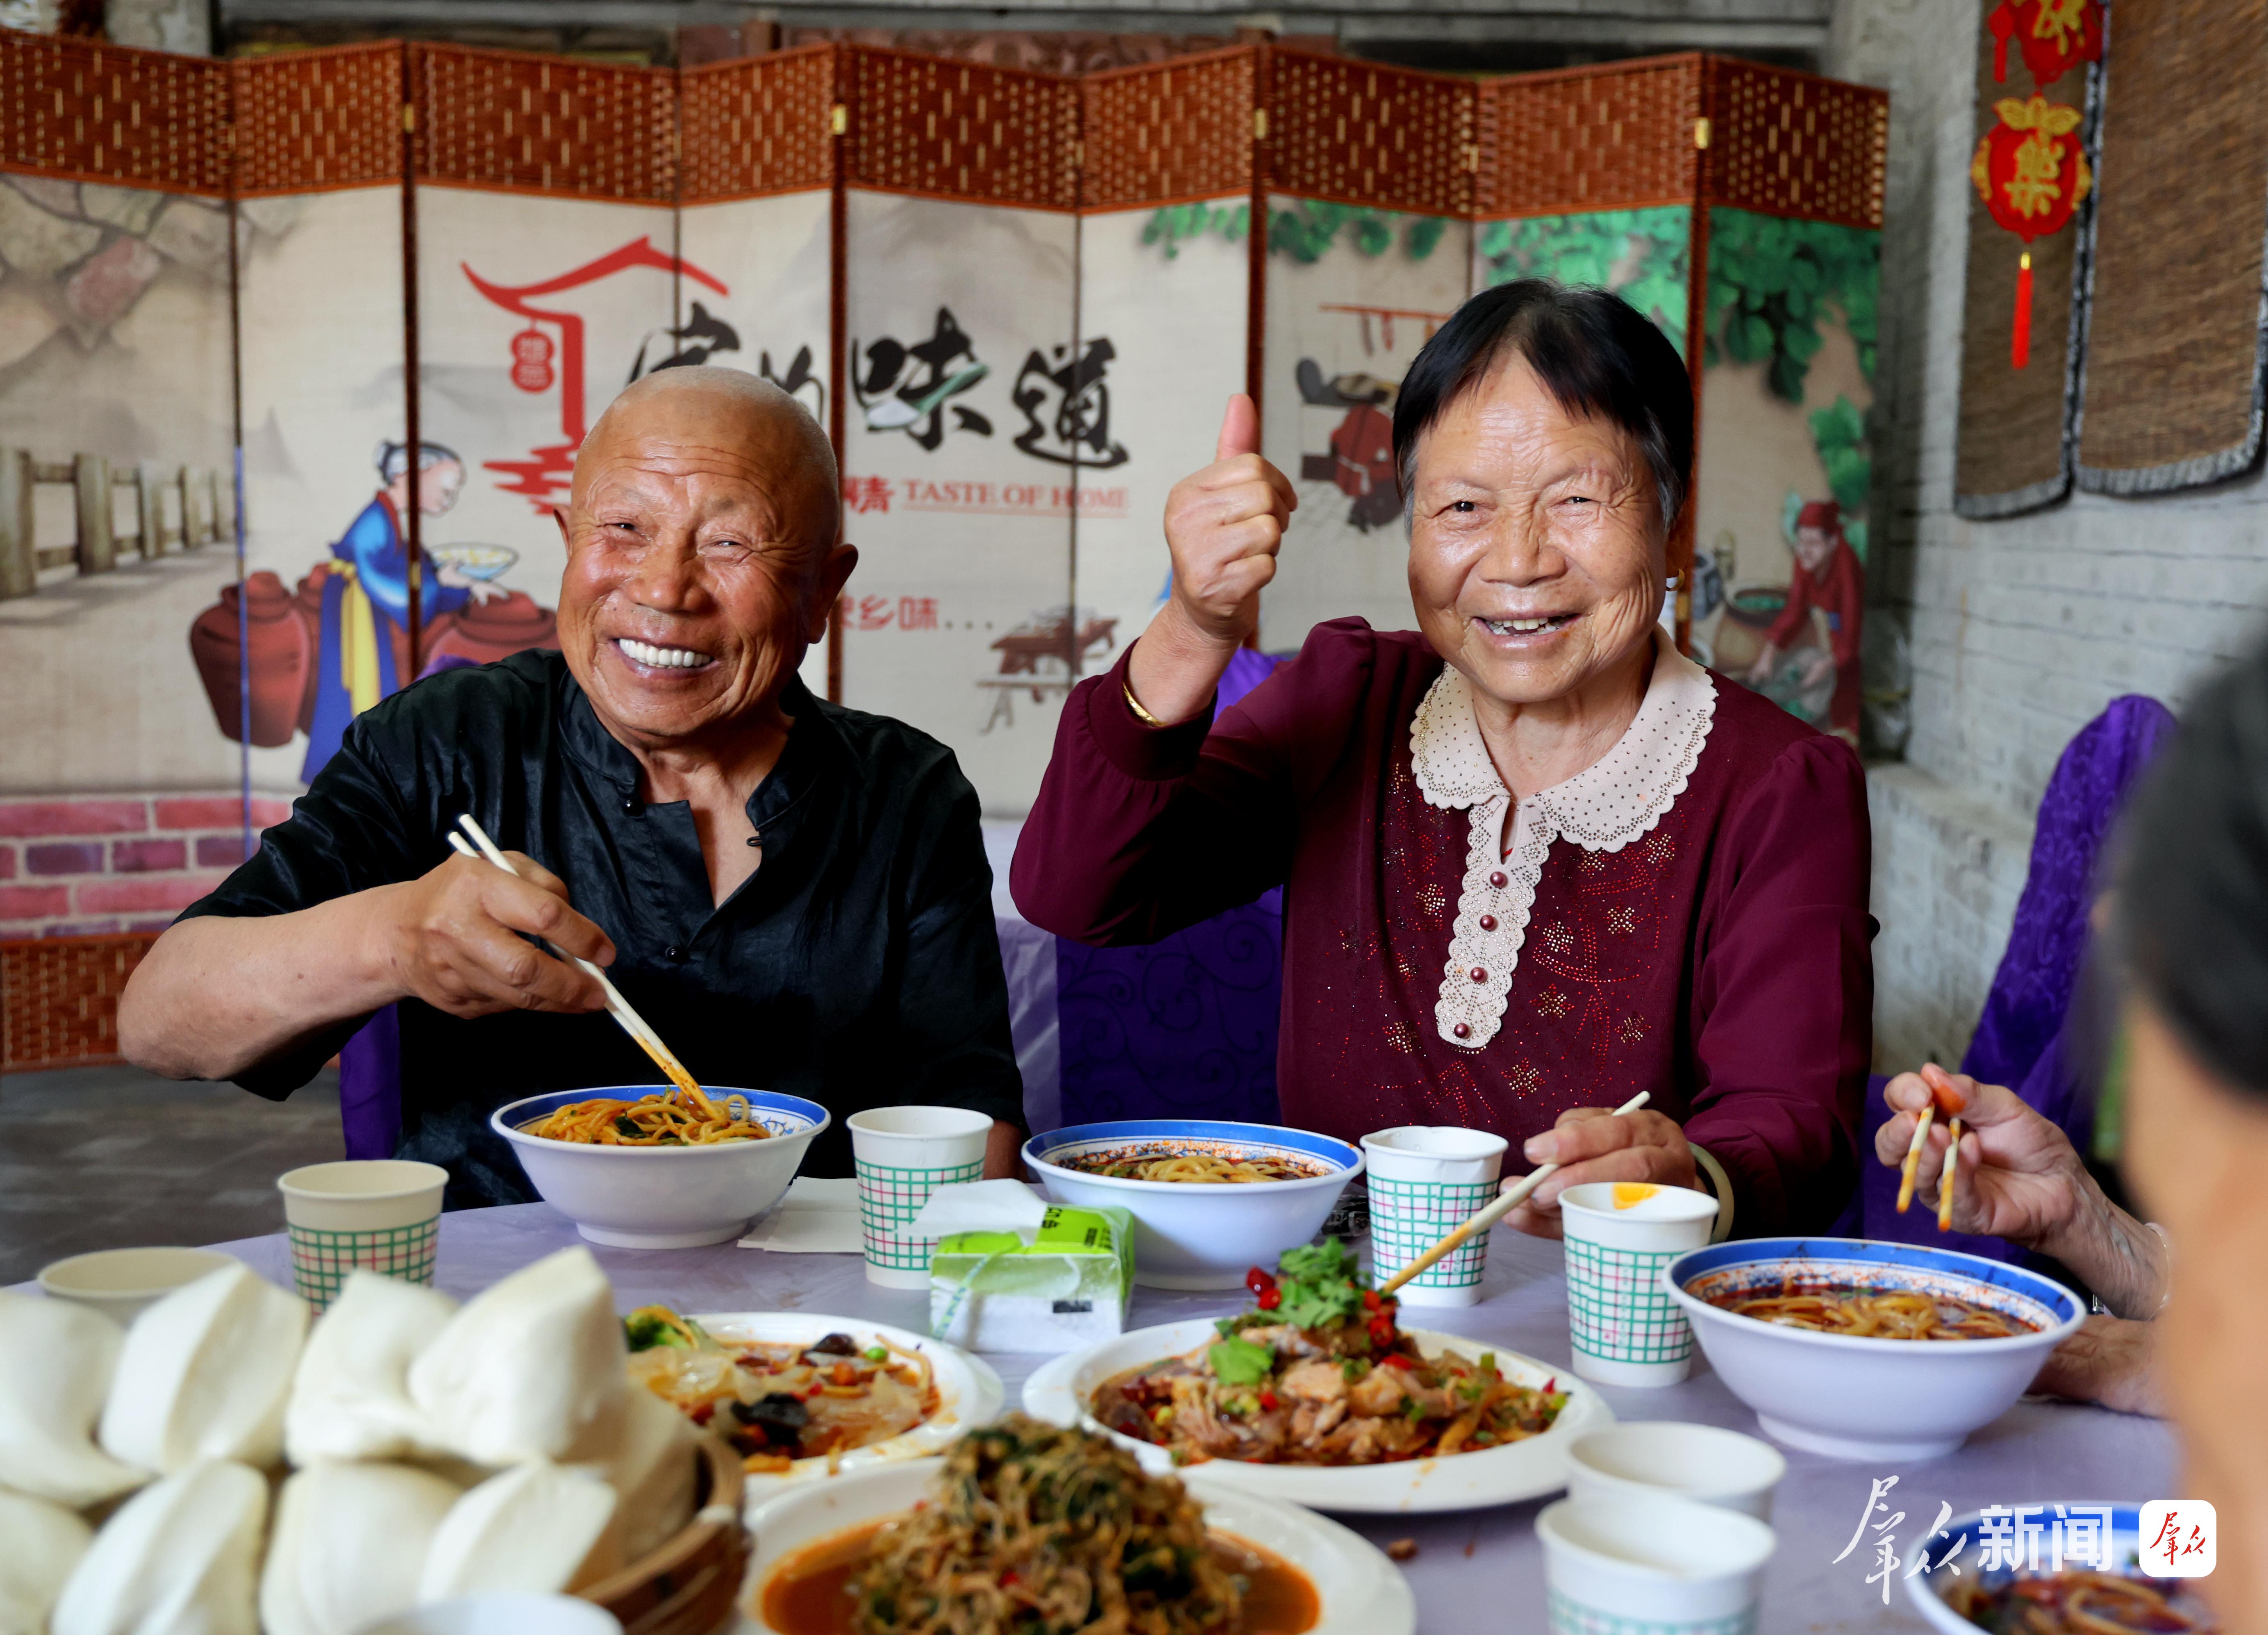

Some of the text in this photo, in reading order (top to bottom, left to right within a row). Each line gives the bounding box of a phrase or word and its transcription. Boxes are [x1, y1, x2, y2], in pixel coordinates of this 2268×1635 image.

[900, 478, 1128, 508] TASTE OF HOME
